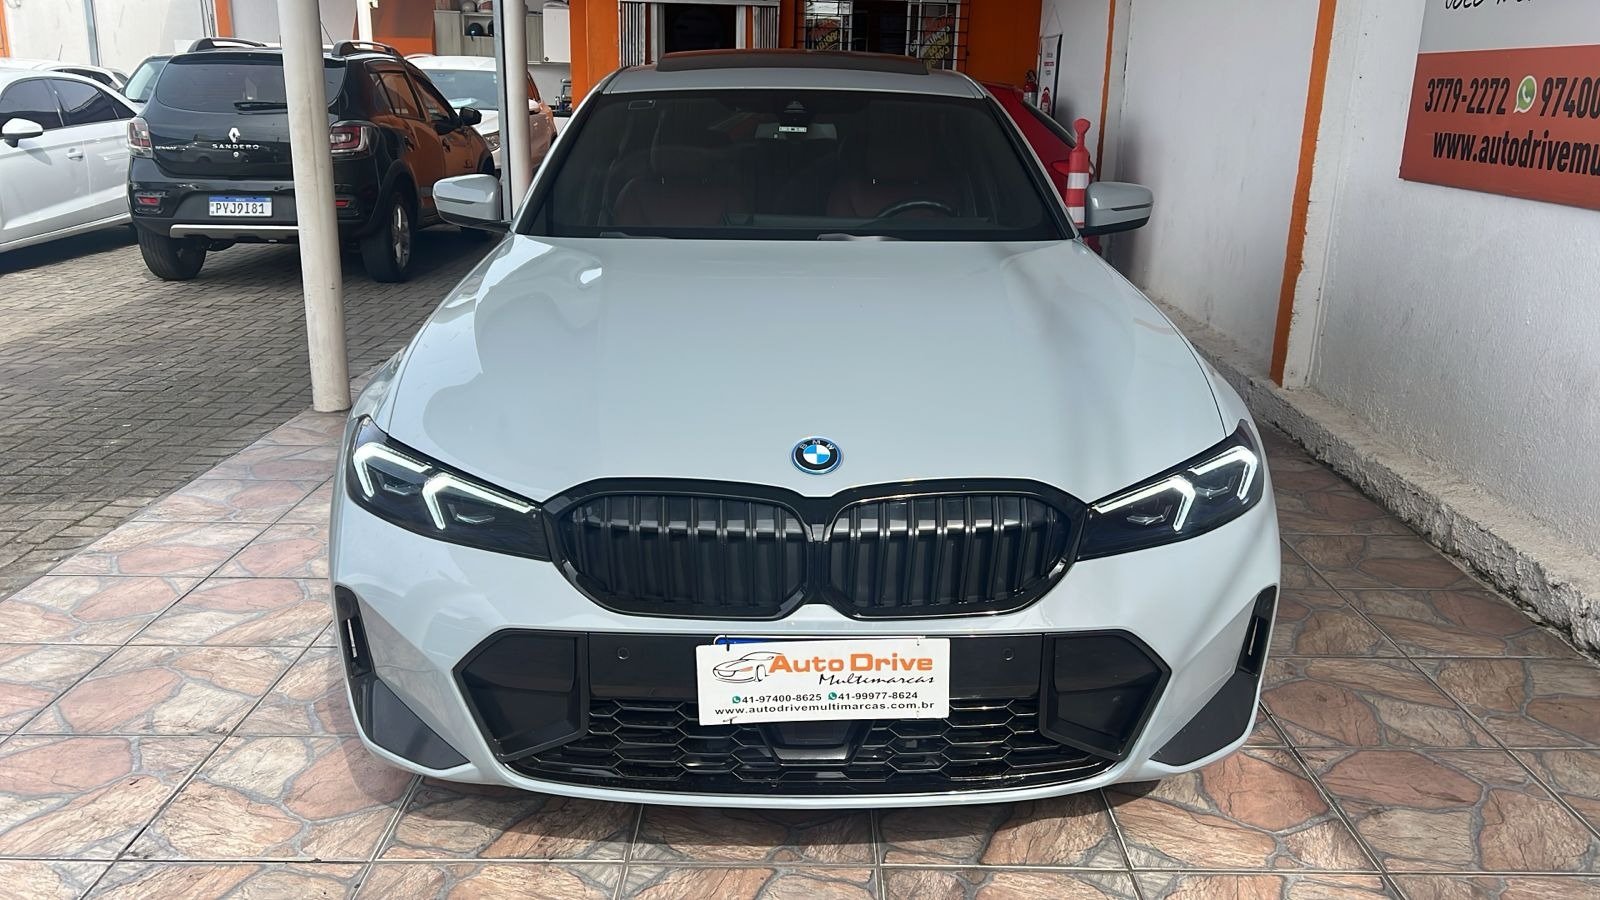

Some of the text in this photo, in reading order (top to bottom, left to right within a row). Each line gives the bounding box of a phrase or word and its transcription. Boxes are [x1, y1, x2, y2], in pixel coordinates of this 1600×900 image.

[1425, 78, 1510, 115] 3779-2272
[215, 203, 265, 214] PYJ9I81
[800, 440, 835, 450] BMW
[769, 653, 933, 673] Auto Drive
[742, 691, 918, 704] 41-97400-8625 41-99977-8624
[714, 701, 935, 715] www.autodrivemultimarcas.com.br
